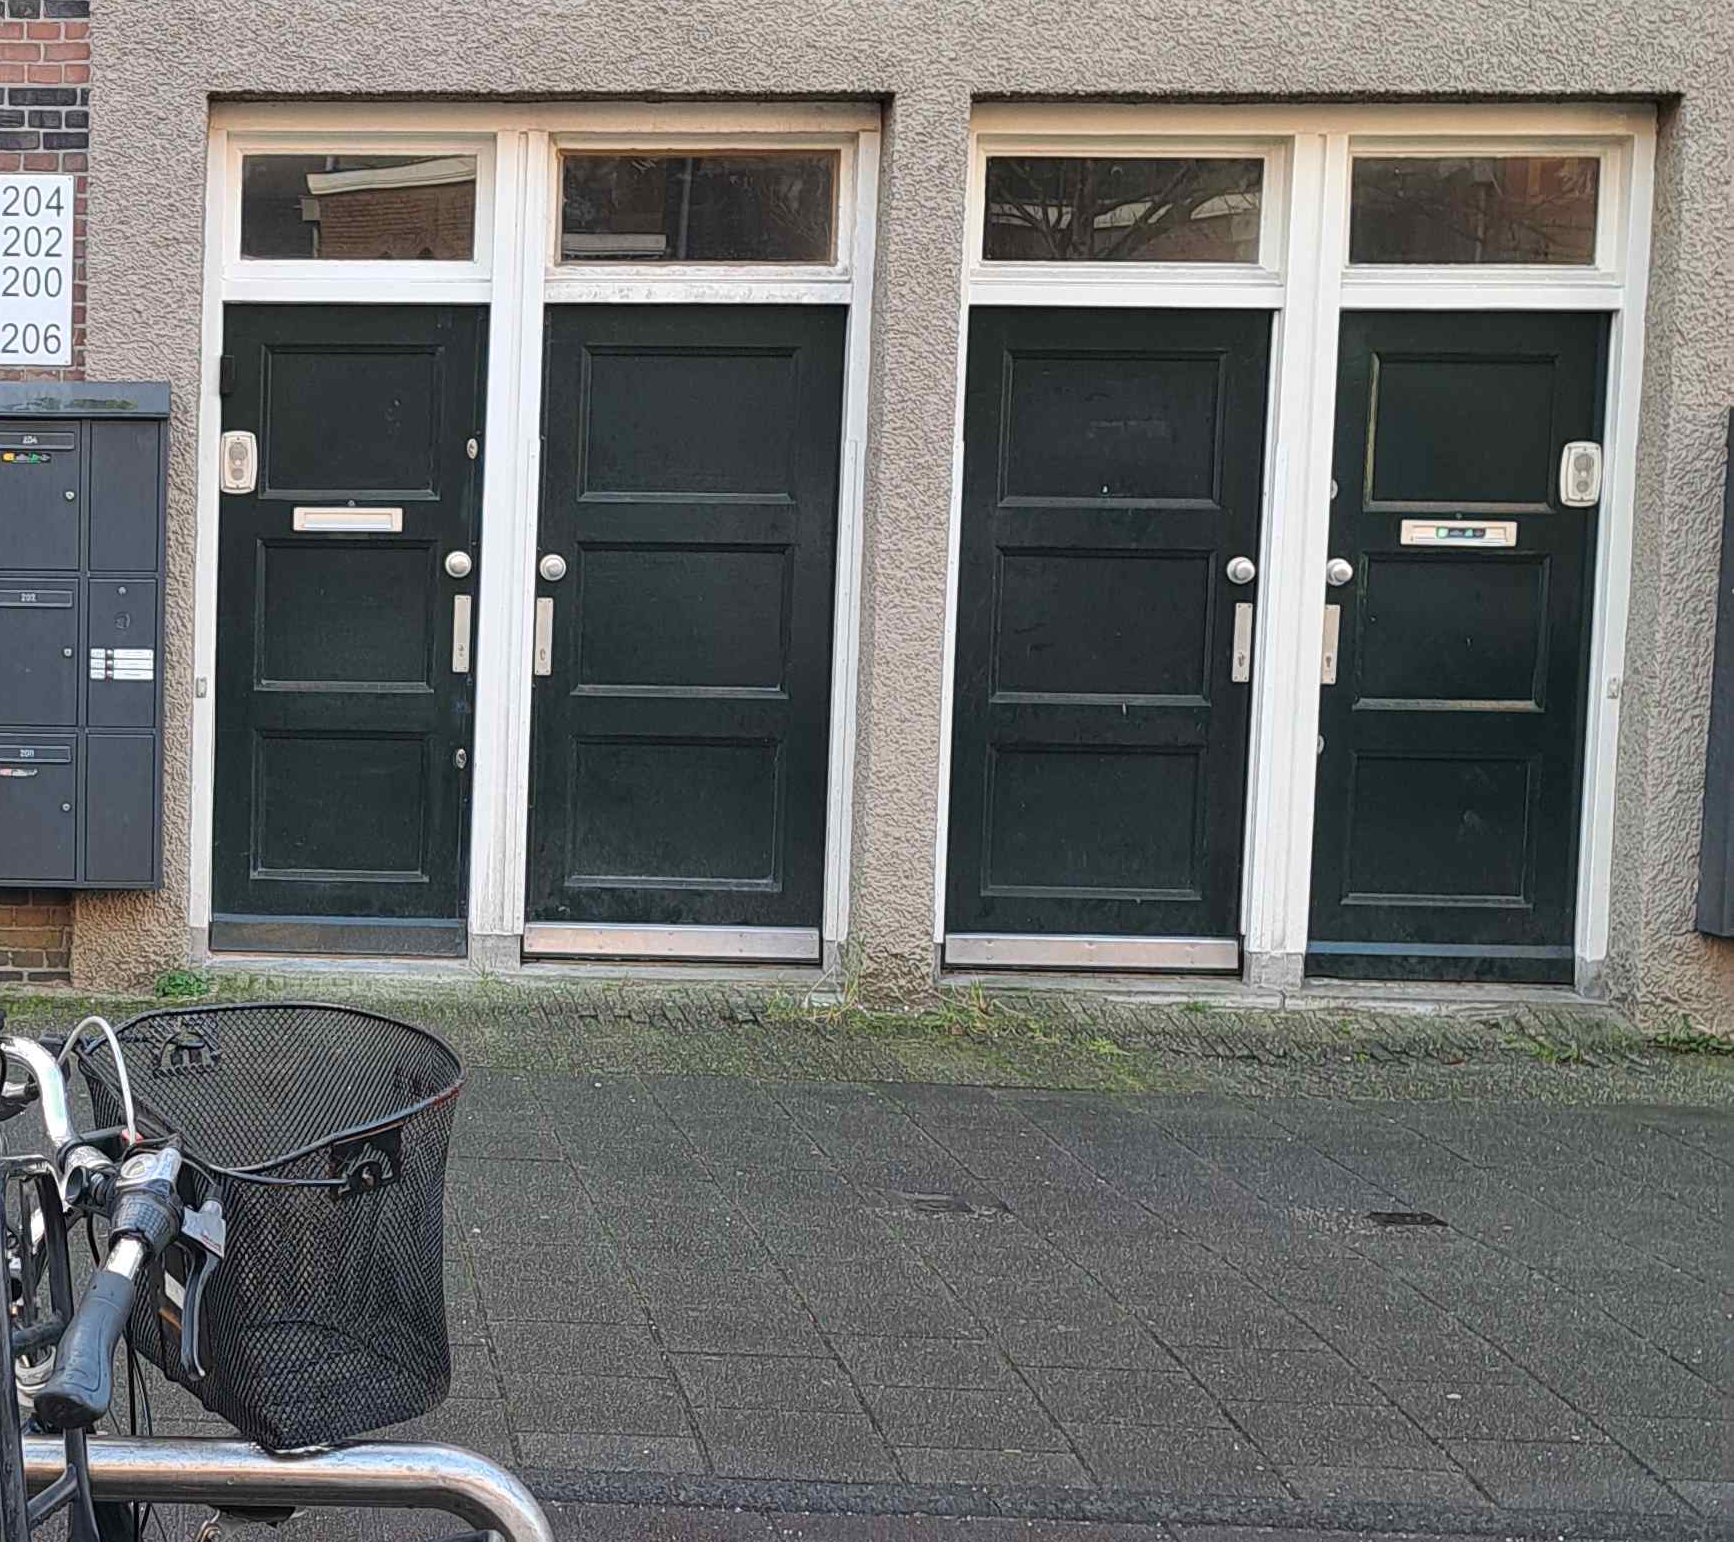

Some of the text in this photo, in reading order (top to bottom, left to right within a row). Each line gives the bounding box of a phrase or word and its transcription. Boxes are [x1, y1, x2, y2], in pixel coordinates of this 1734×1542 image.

[1, 185, 65, 217] 204
[1, 225, 63, 257] 202
[1, 265, 63, 297] 200
[0, 322, 62, 354] 206
